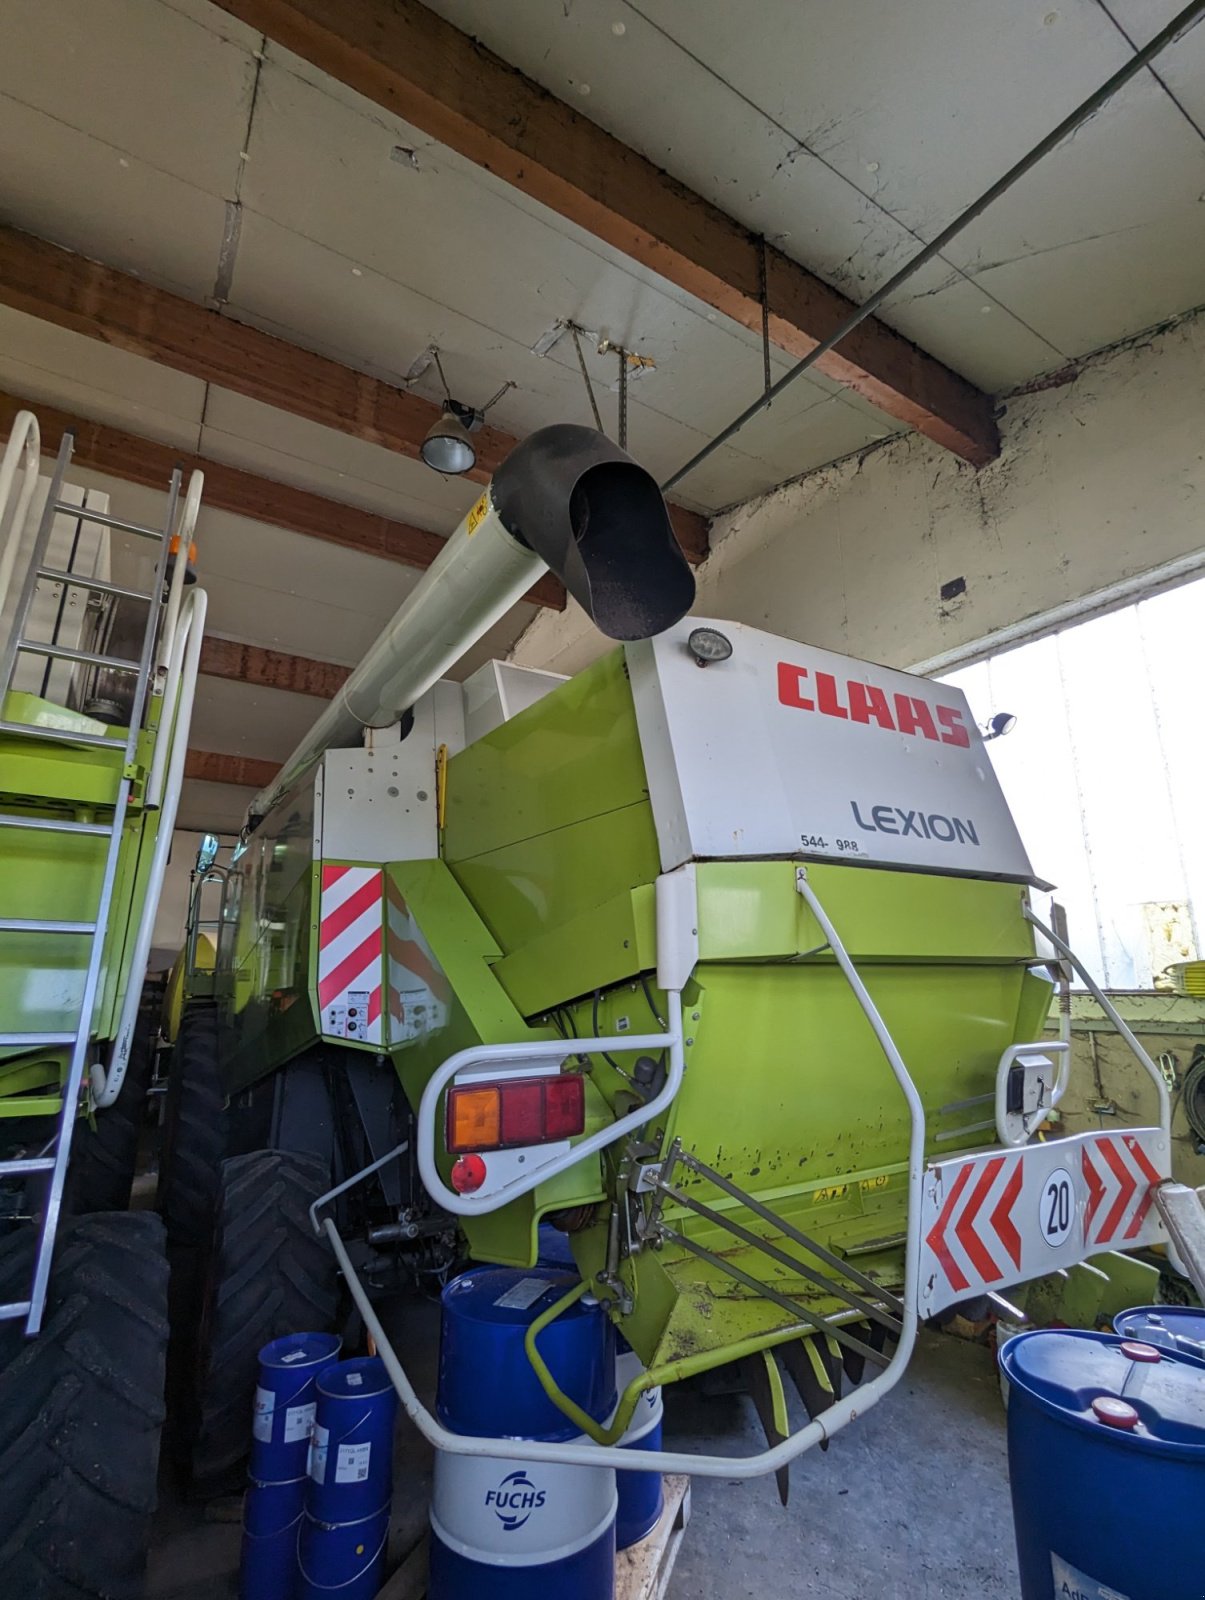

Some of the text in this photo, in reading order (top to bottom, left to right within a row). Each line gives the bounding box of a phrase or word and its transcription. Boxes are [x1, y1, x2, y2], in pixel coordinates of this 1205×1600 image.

[778, 662, 969, 748] CLAAS
[850, 800, 980, 846] LEXION
[1047, 1180, 1069, 1235] 20
[485, 1490, 546, 1509] FUCHS
